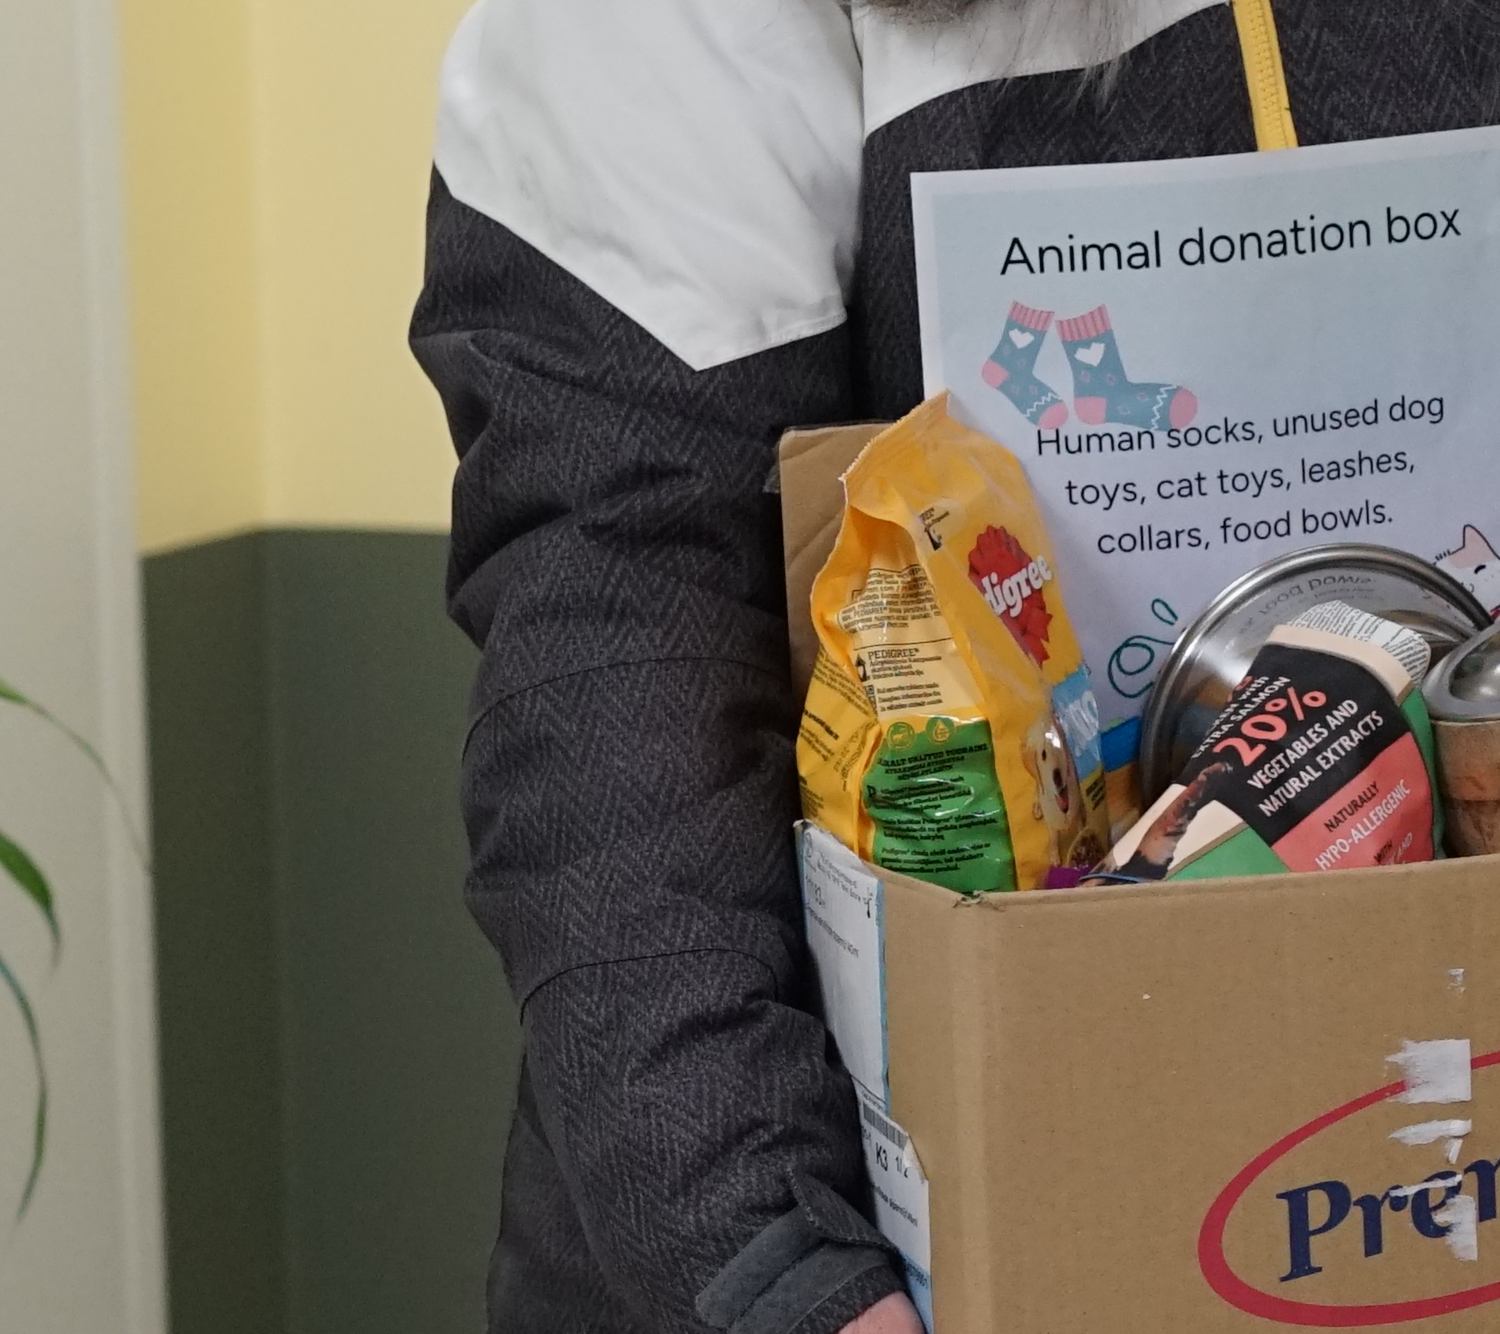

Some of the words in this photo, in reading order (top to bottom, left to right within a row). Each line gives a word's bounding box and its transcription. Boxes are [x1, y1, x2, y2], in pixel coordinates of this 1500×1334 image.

[999, 230, 1162, 276] Animal
[1178, 213, 1372, 266] donation
[1386, 206, 1462, 244] box
[1037, 427, 1155, 456] Human
[1167, 416, 1264, 449] socks,
[1272, 399, 1380, 441] unused
[1389, 394, 1445, 429] dog
[1065, 476, 1147, 511] toys,
[1156, 471, 1207, 502] cat
[1217, 462, 1292, 495] toys,
[1300, 449, 1415, 486] leashes,
[1098, 520, 1210, 555] collars,
[1219, 511, 1292, 545] food
[1300, 501, 1393, 536] bowls.
[974, 554, 1053, 618] digree
[1214, 687, 1326, 766] 20%
[1231, 676, 1291, 725] SALMON
[1248, 723, 1328, 790] VEGETABLES
[1328, 699, 1358, 731] AND
[1258, 767, 1322, 817] NATURAL
[1319, 711, 1384, 771] EXTRACTS
[1315, 779, 1410, 871] HYPO-ALLERGENIC
[1324, 781, 1381, 832] NATURALLY
